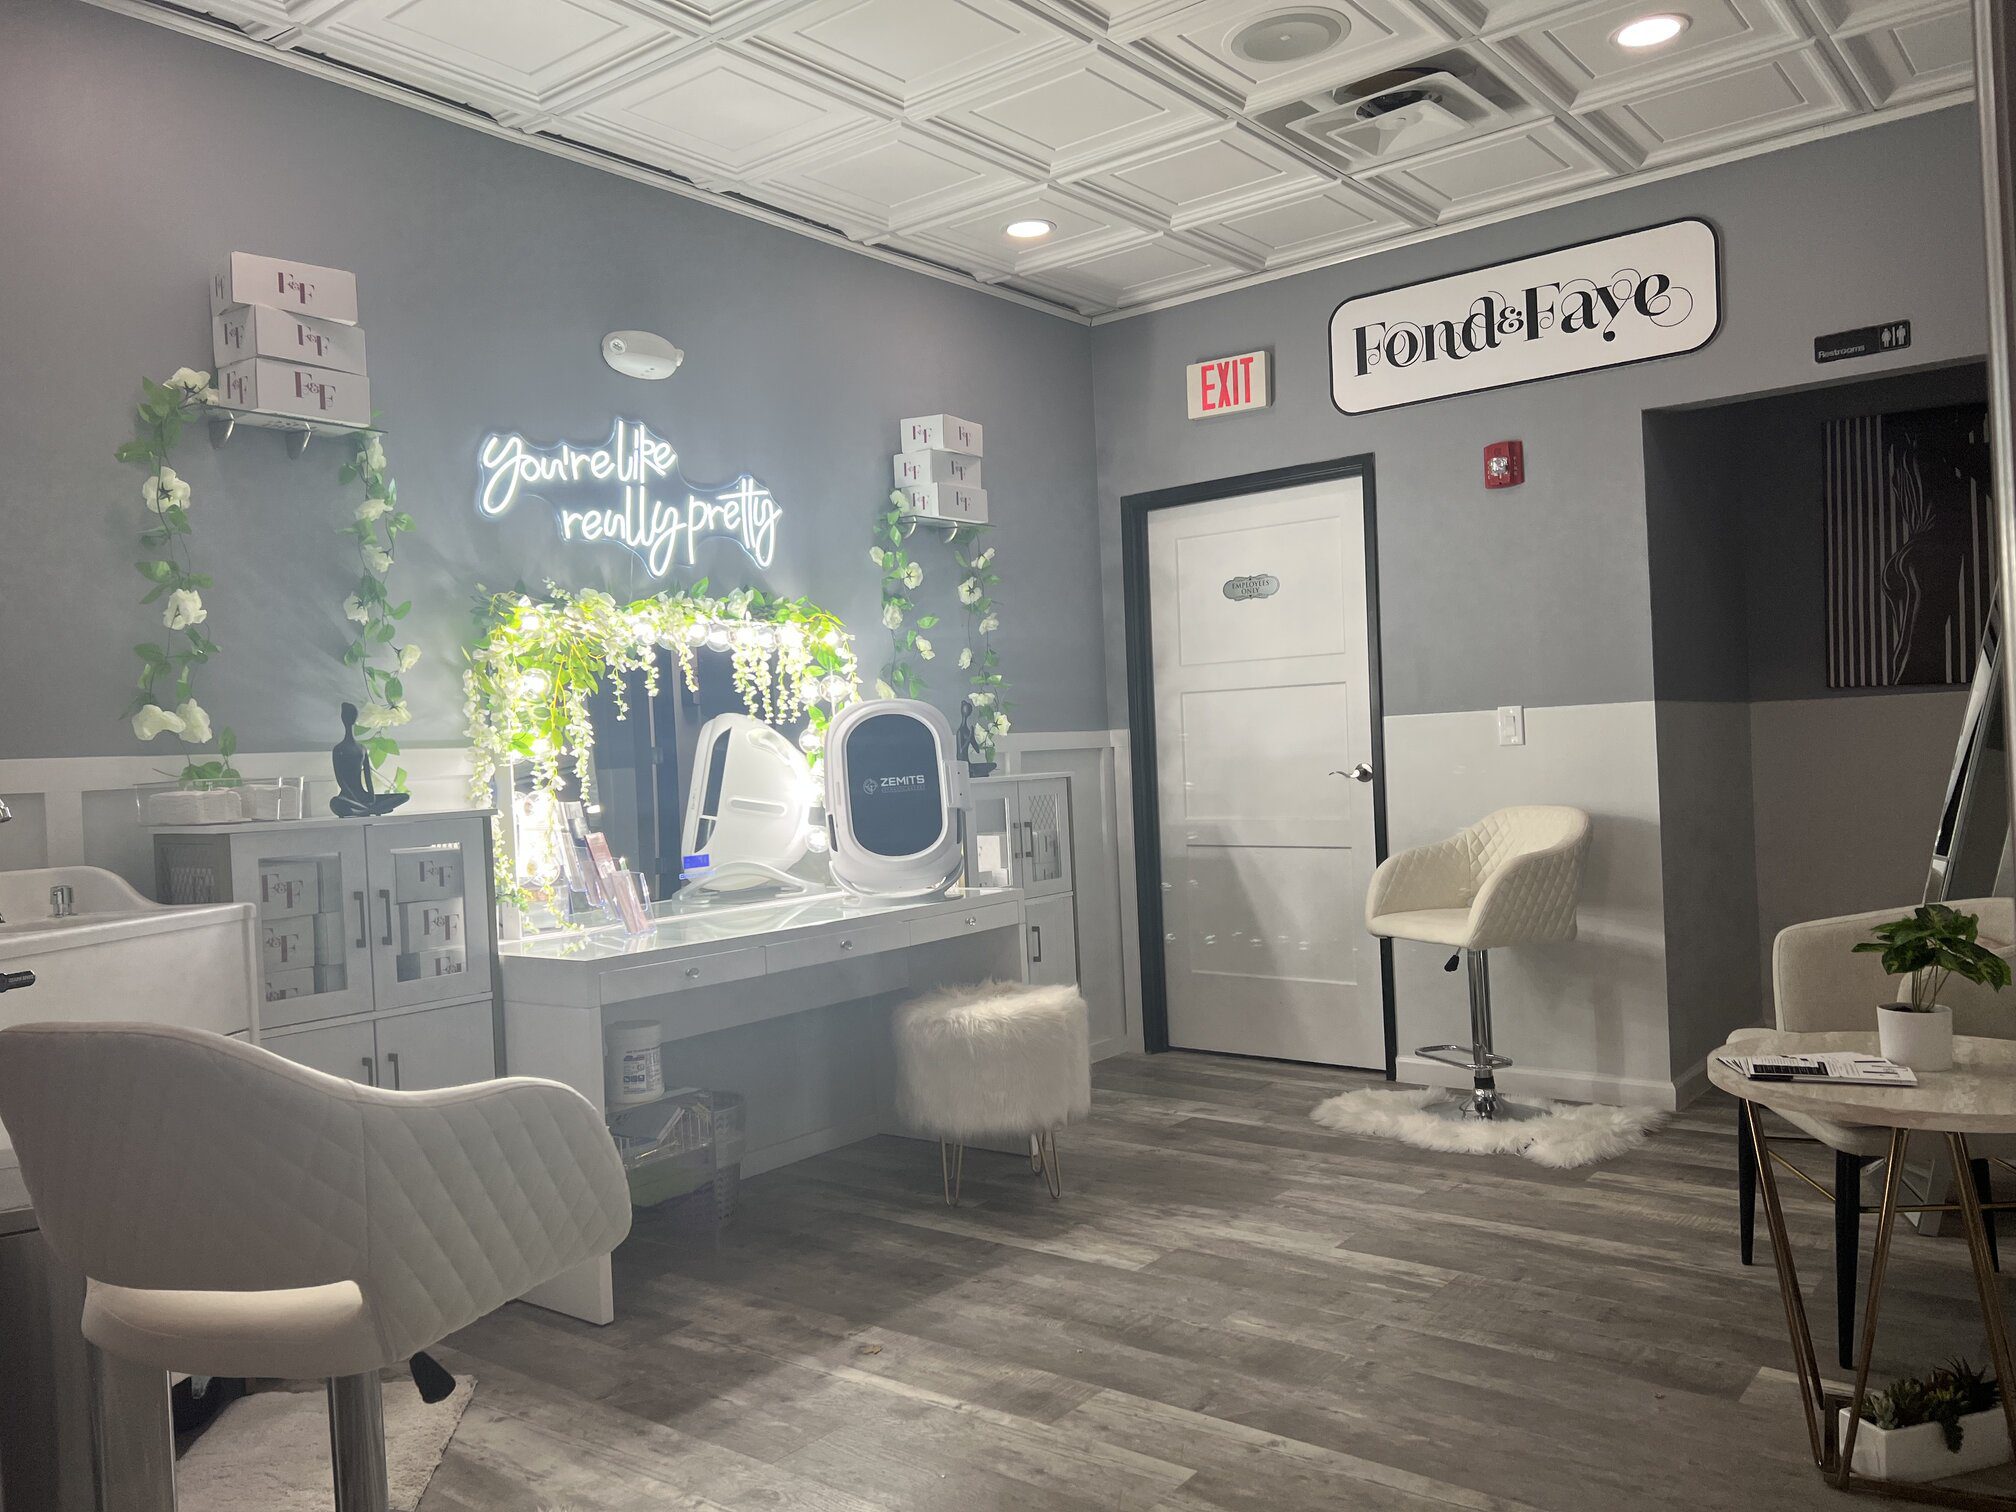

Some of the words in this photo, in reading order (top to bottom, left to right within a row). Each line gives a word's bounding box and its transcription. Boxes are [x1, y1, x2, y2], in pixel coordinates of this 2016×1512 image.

[1818, 344, 1866, 359] Restrooms
[294, 371, 337, 411] F&F
[1201, 356, 1254, 411] EXIT
[687, 477, 783, 568] pretty
[1231, 579, 1270, 590] EMPLOYEES
[1240, 586, 1260, 595] ONLY
[880, 774, 925, 787] ZEMITS
[261, 873, 304, 909] F&F
[423, 908, 460, 941] F&F
